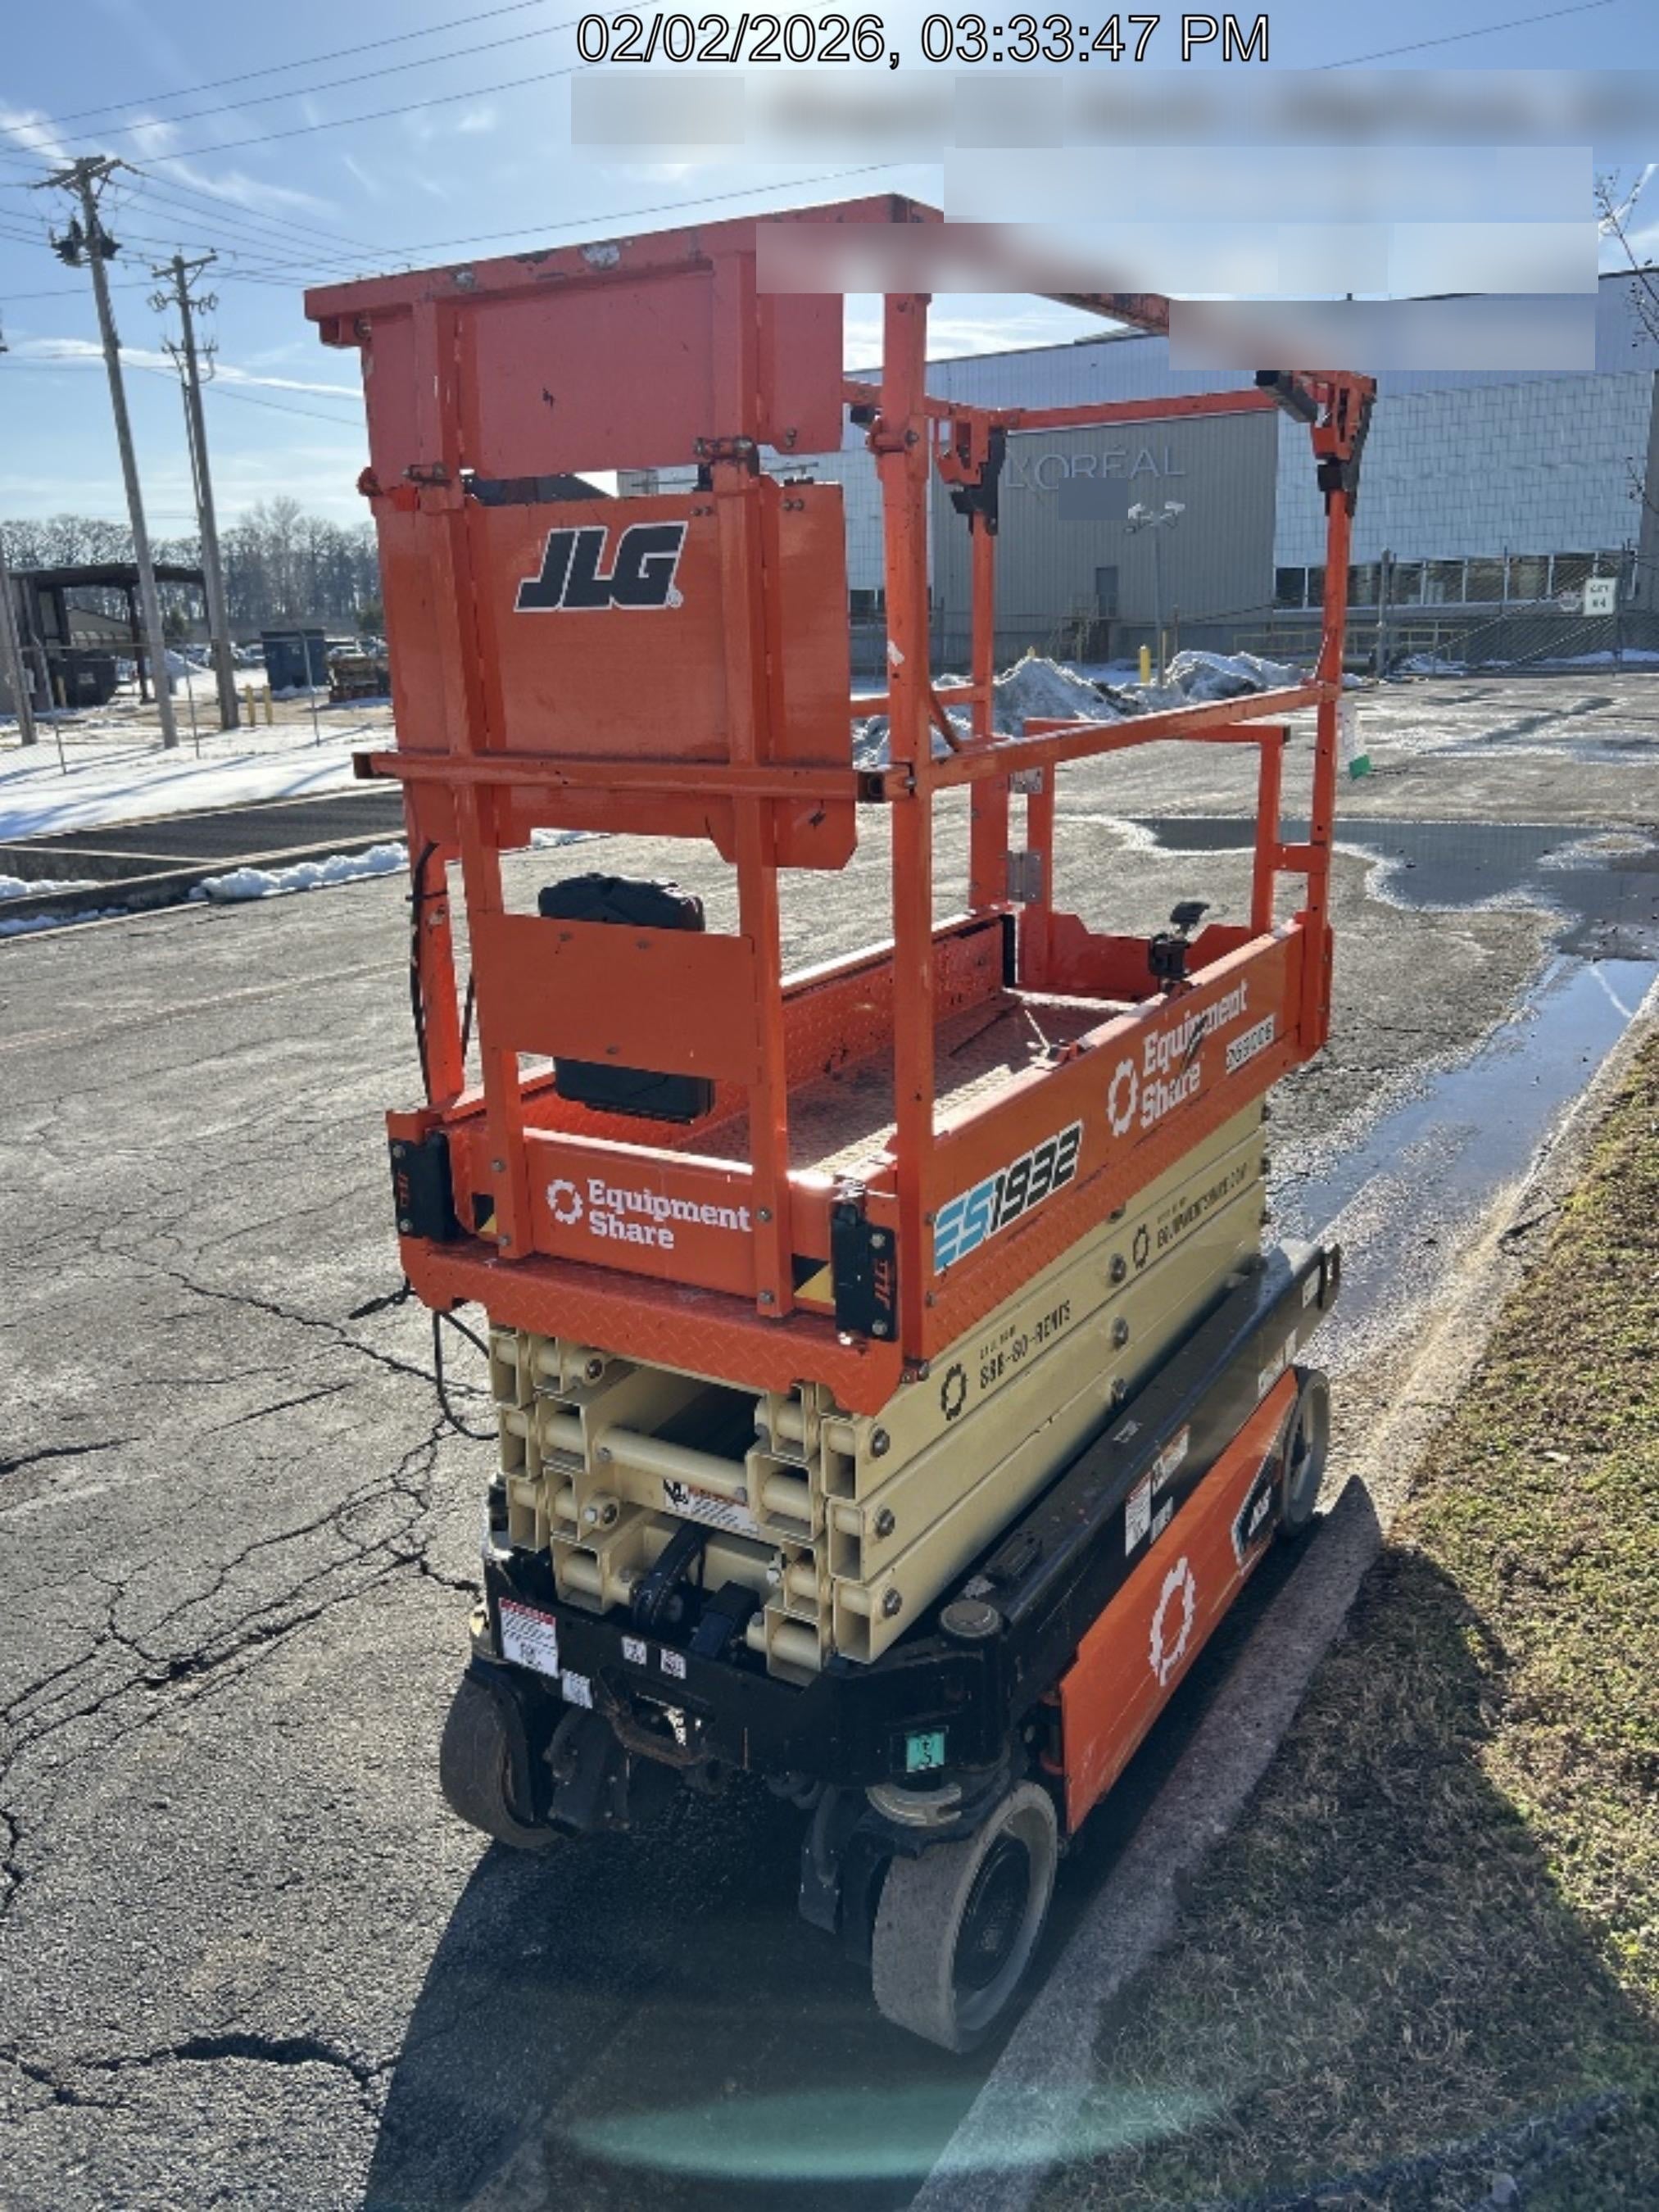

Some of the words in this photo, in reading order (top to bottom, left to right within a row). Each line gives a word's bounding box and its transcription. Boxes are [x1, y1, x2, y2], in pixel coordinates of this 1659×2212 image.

[514, 520, 688, 613] JLG
[1140, 1062, 1201, 1128] Share
[587, 1178, 753, 1232] Equipment
[589, 1209, 675, 1249] Share
[934, 1119, 1083, 1276] ES1932
